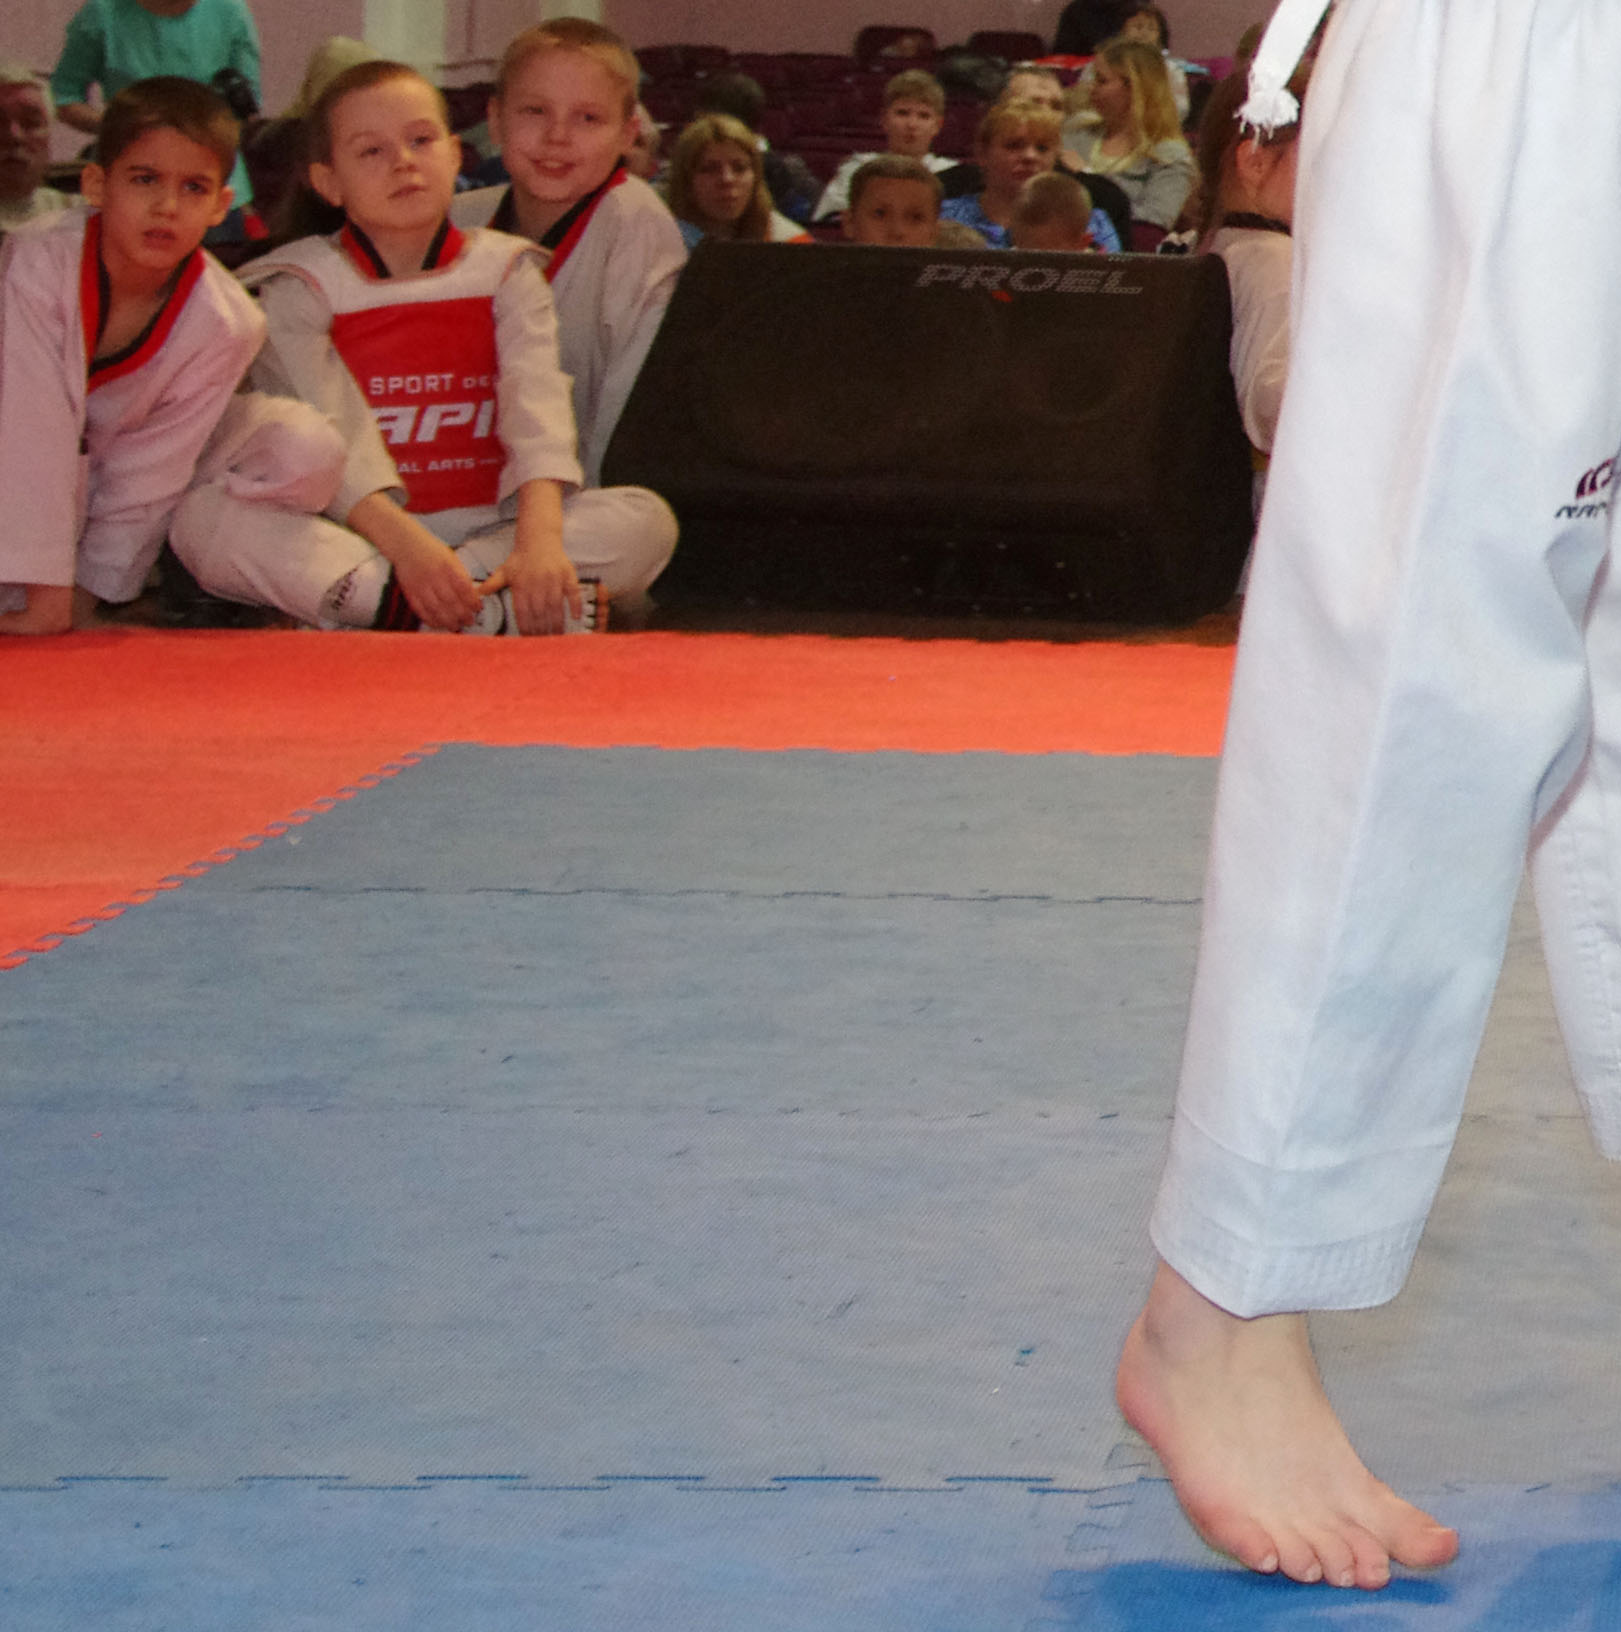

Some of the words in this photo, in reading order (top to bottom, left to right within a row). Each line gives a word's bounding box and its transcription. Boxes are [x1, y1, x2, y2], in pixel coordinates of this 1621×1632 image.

[915, 265, 1143, 294] PROEL
[369, 373, 454, 396] SPORT
[370, 399, 496, 445] API
[428, 457, 477, 472] ARTS
